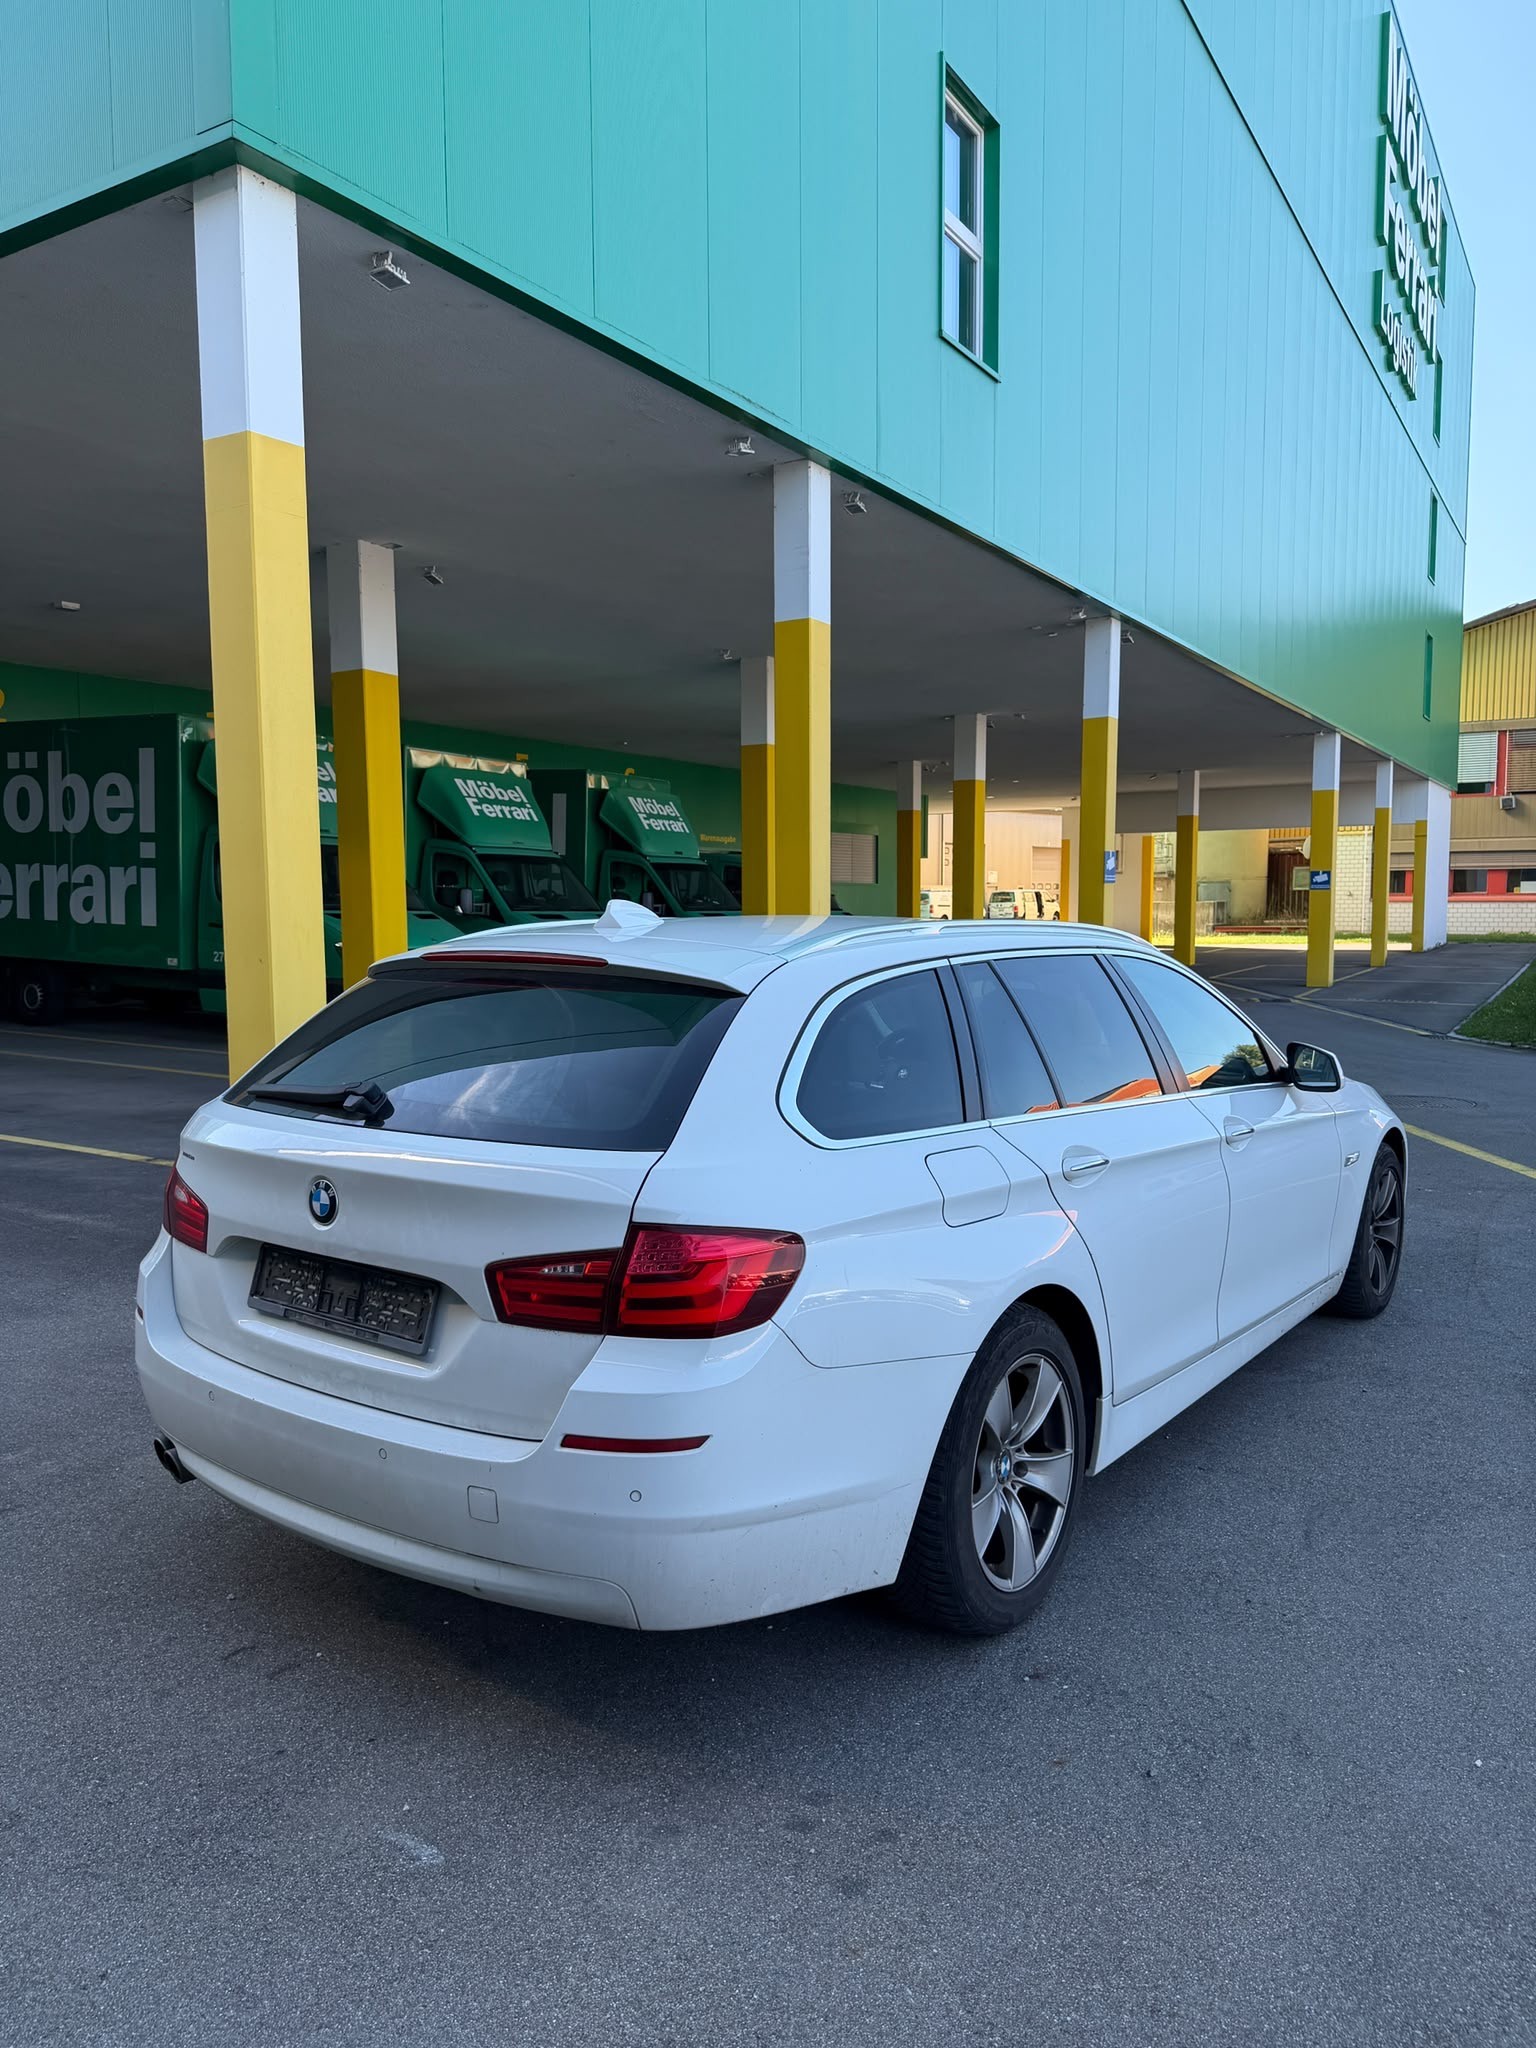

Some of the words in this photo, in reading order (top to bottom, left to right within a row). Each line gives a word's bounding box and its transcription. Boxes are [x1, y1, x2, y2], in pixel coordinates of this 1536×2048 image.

[1382, 11, 1442, 266] Möbel
[1378, 135, 1438, 364] Ferrari
[1375, 270, 1417, 401] Logistik
[3, 748, 156, 835] öbel
[454, 778, 528, 803] Möbel
[465, 797, 539, 822] Ferrari
[628, 796, 681, 817] Möbel
[637, 813, 690, 834] Ferrari
[0, 841, 157, 927] rrari
